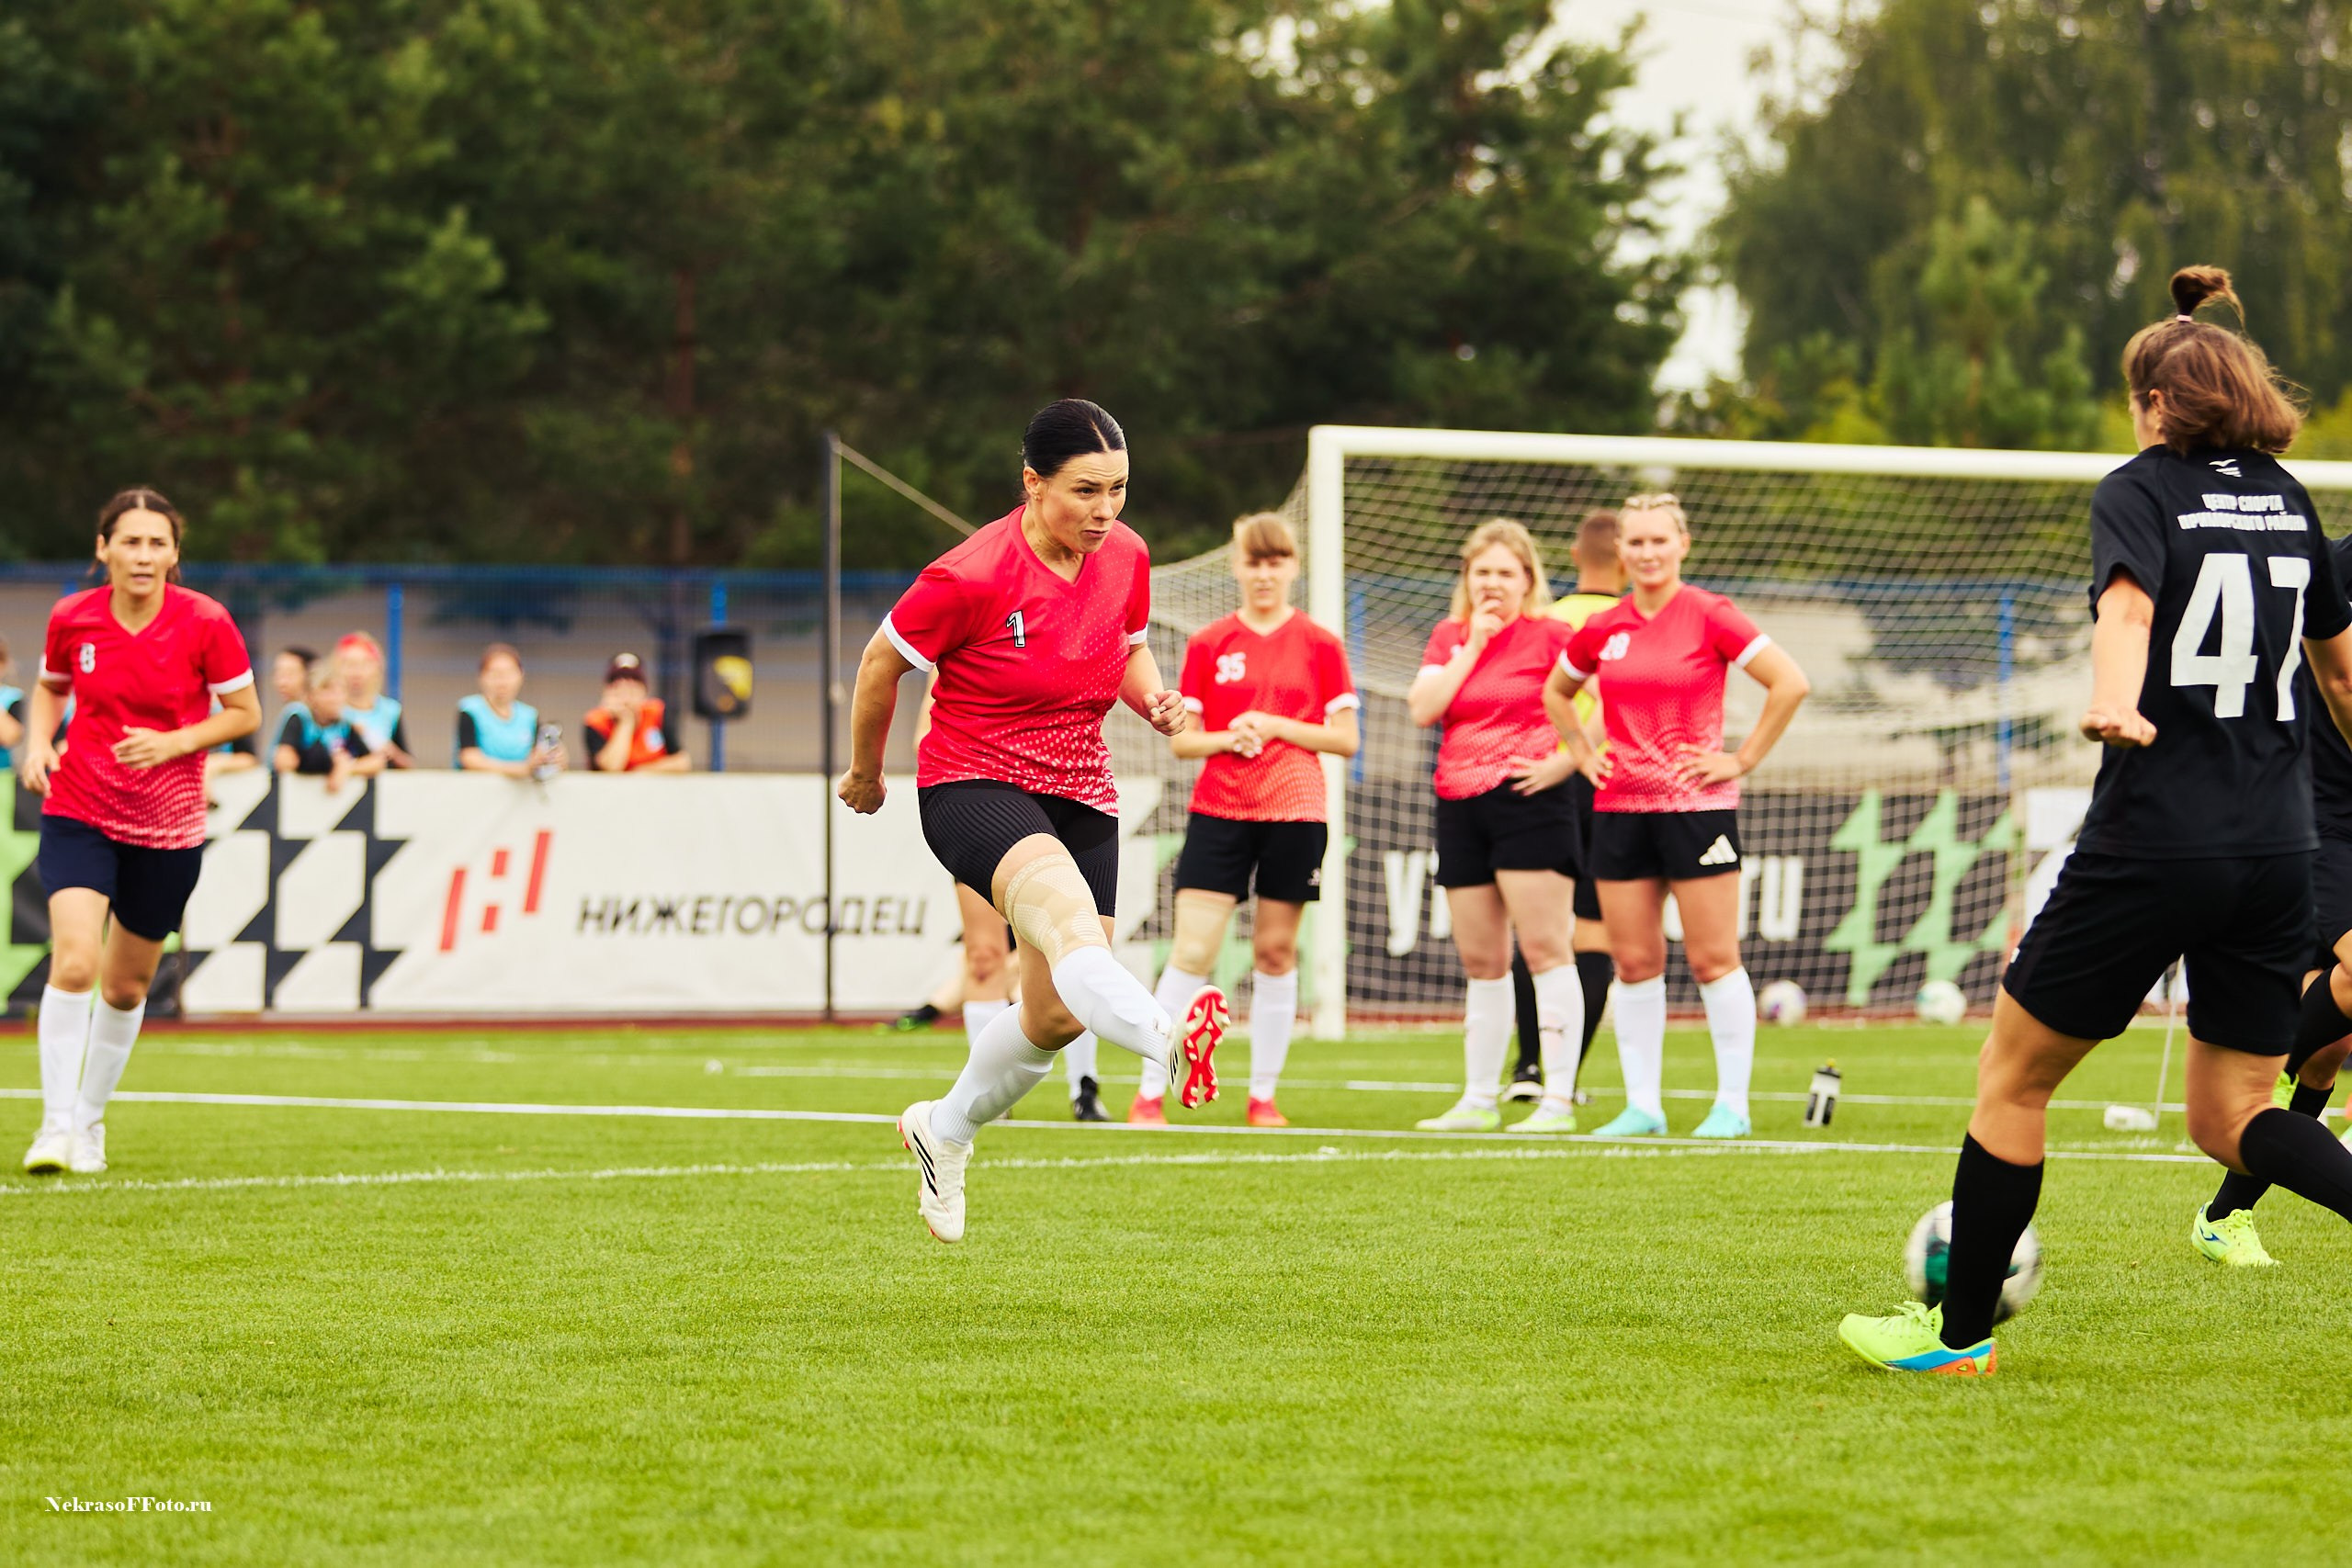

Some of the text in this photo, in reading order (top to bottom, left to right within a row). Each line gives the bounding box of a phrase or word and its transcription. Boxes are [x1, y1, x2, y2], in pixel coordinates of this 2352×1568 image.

[1006, 610, 1025, 648] 1
[2170, 553, 2312, 722] 47
[1215, 651, 1247, 684] 35
[575, 894, 929, 936] НИЖЕГОРОДЕЦ
